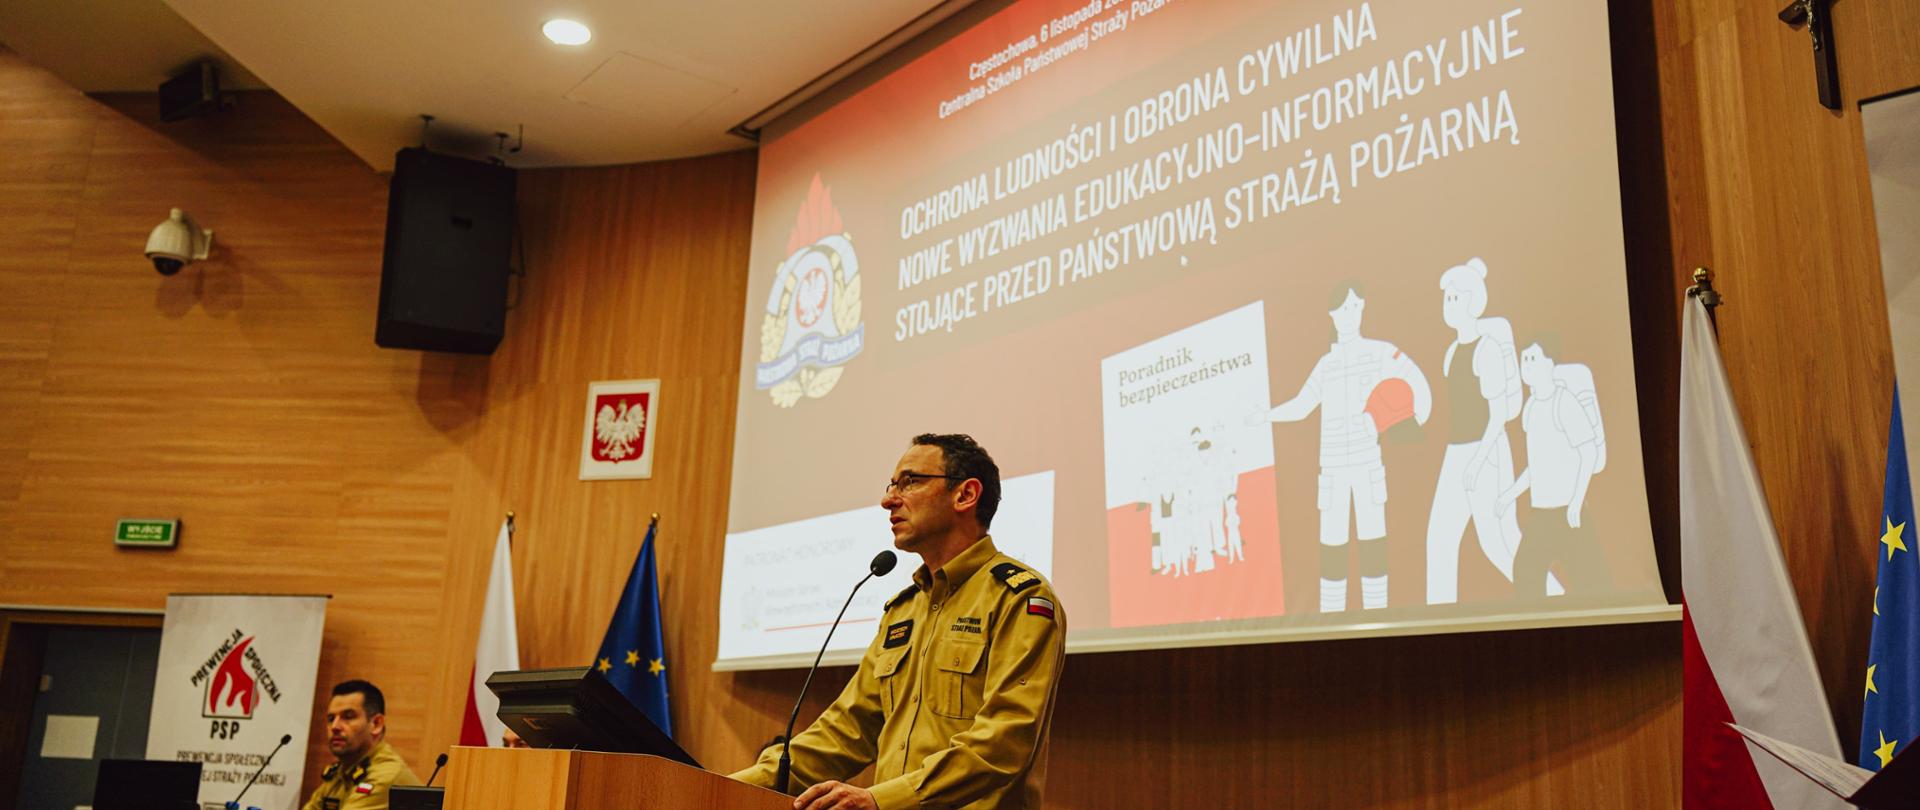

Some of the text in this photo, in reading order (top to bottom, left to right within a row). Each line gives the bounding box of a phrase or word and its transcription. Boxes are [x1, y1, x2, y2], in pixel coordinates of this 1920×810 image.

[939, 83, 986, 119] Centralna
[987, 64, 1022, 94] Szkoła
[1024, 27, 1089, 76] Państwowej
[1091, 9, 1129, 41] Straży
[1041, 24, 1048, 43] 6
[901, 2, 1377, 240] OCHRONA LUDNOŚCI I OBRONA CYWILNA
[895, 89, 1520, 342] STOJĄCE PRZED PAŃSTWOWĄ STRAŻĄ POŻARNĄ
[898, 239, 953, 290] NOWE
[959, 193, 1068, 267] WYZWANIA
[1119, 347, 1193, 387] Poradnik
[1119, 352, 1252, 408] bezpieczeństwa
[191, 628, 282, 704] PREWENCJA SPOŁECZNA
[177, 751, 222, 764] PREWENCJA
[210, 720, 240, 740] PSP
